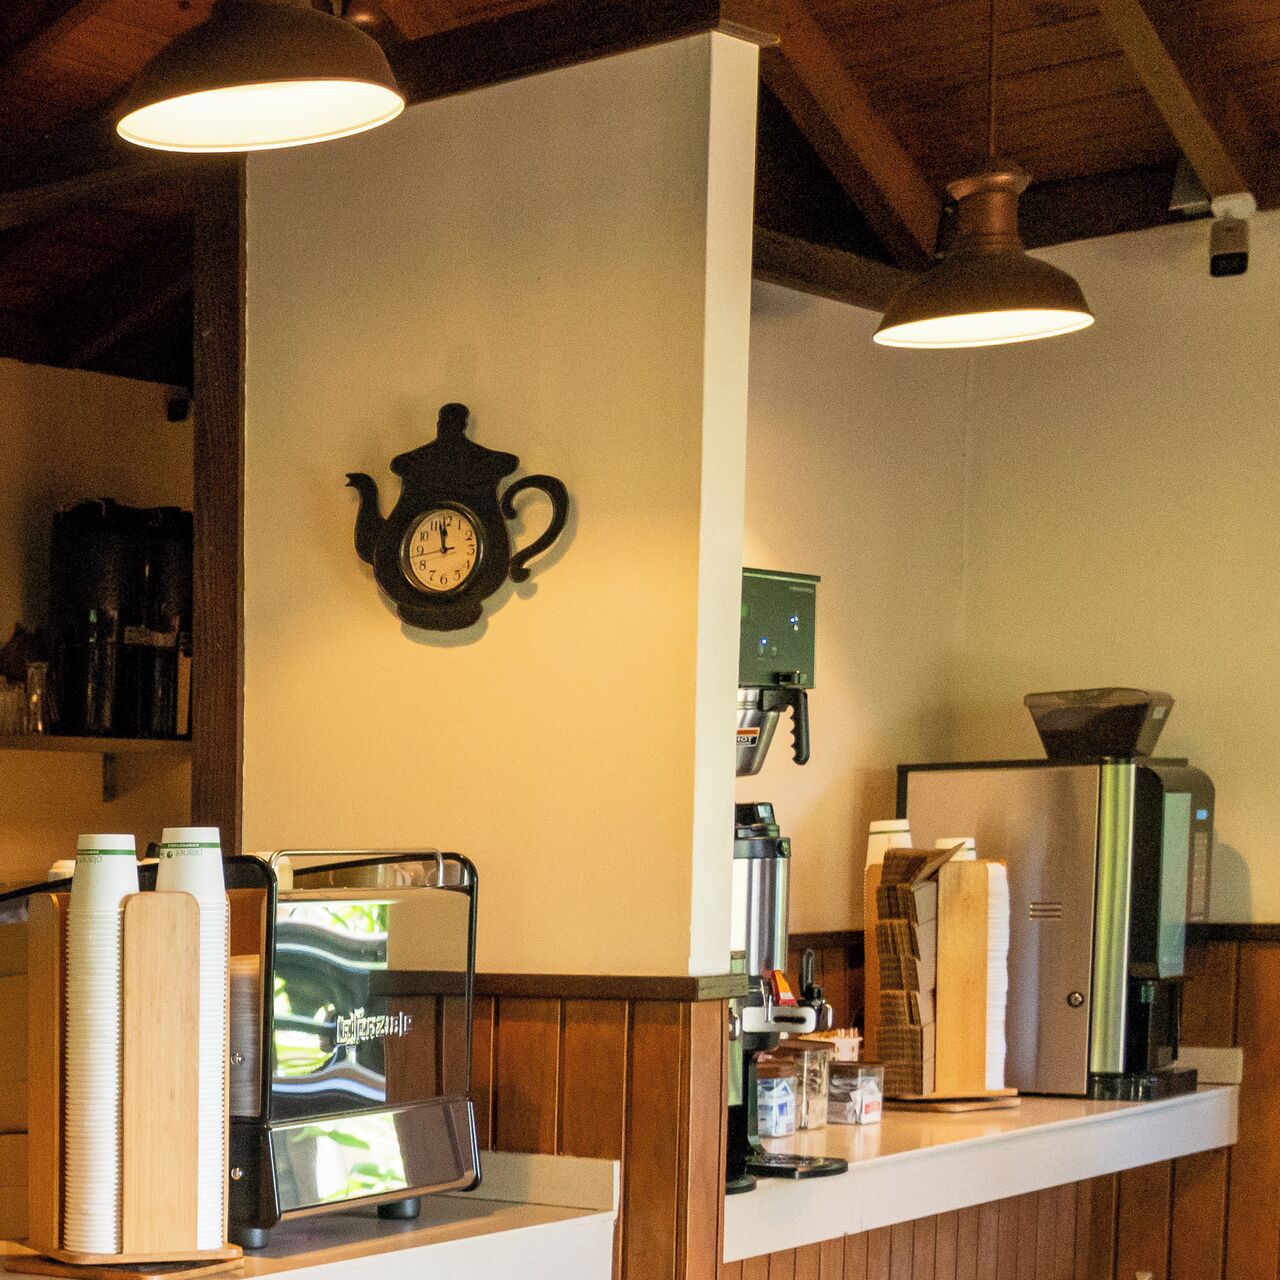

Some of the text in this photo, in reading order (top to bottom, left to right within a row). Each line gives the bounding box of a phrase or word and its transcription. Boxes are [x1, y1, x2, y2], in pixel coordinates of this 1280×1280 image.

[420, 530, 429, 541] 10
[465, 530, 473, 541] 2
[416, 545, 424, 556] 9
[467, 544, 475, 556] 3
[419, 560, 427, 570] 8
[429, 570, 436, 581] 7
[440, 574, 448, 585] 6
